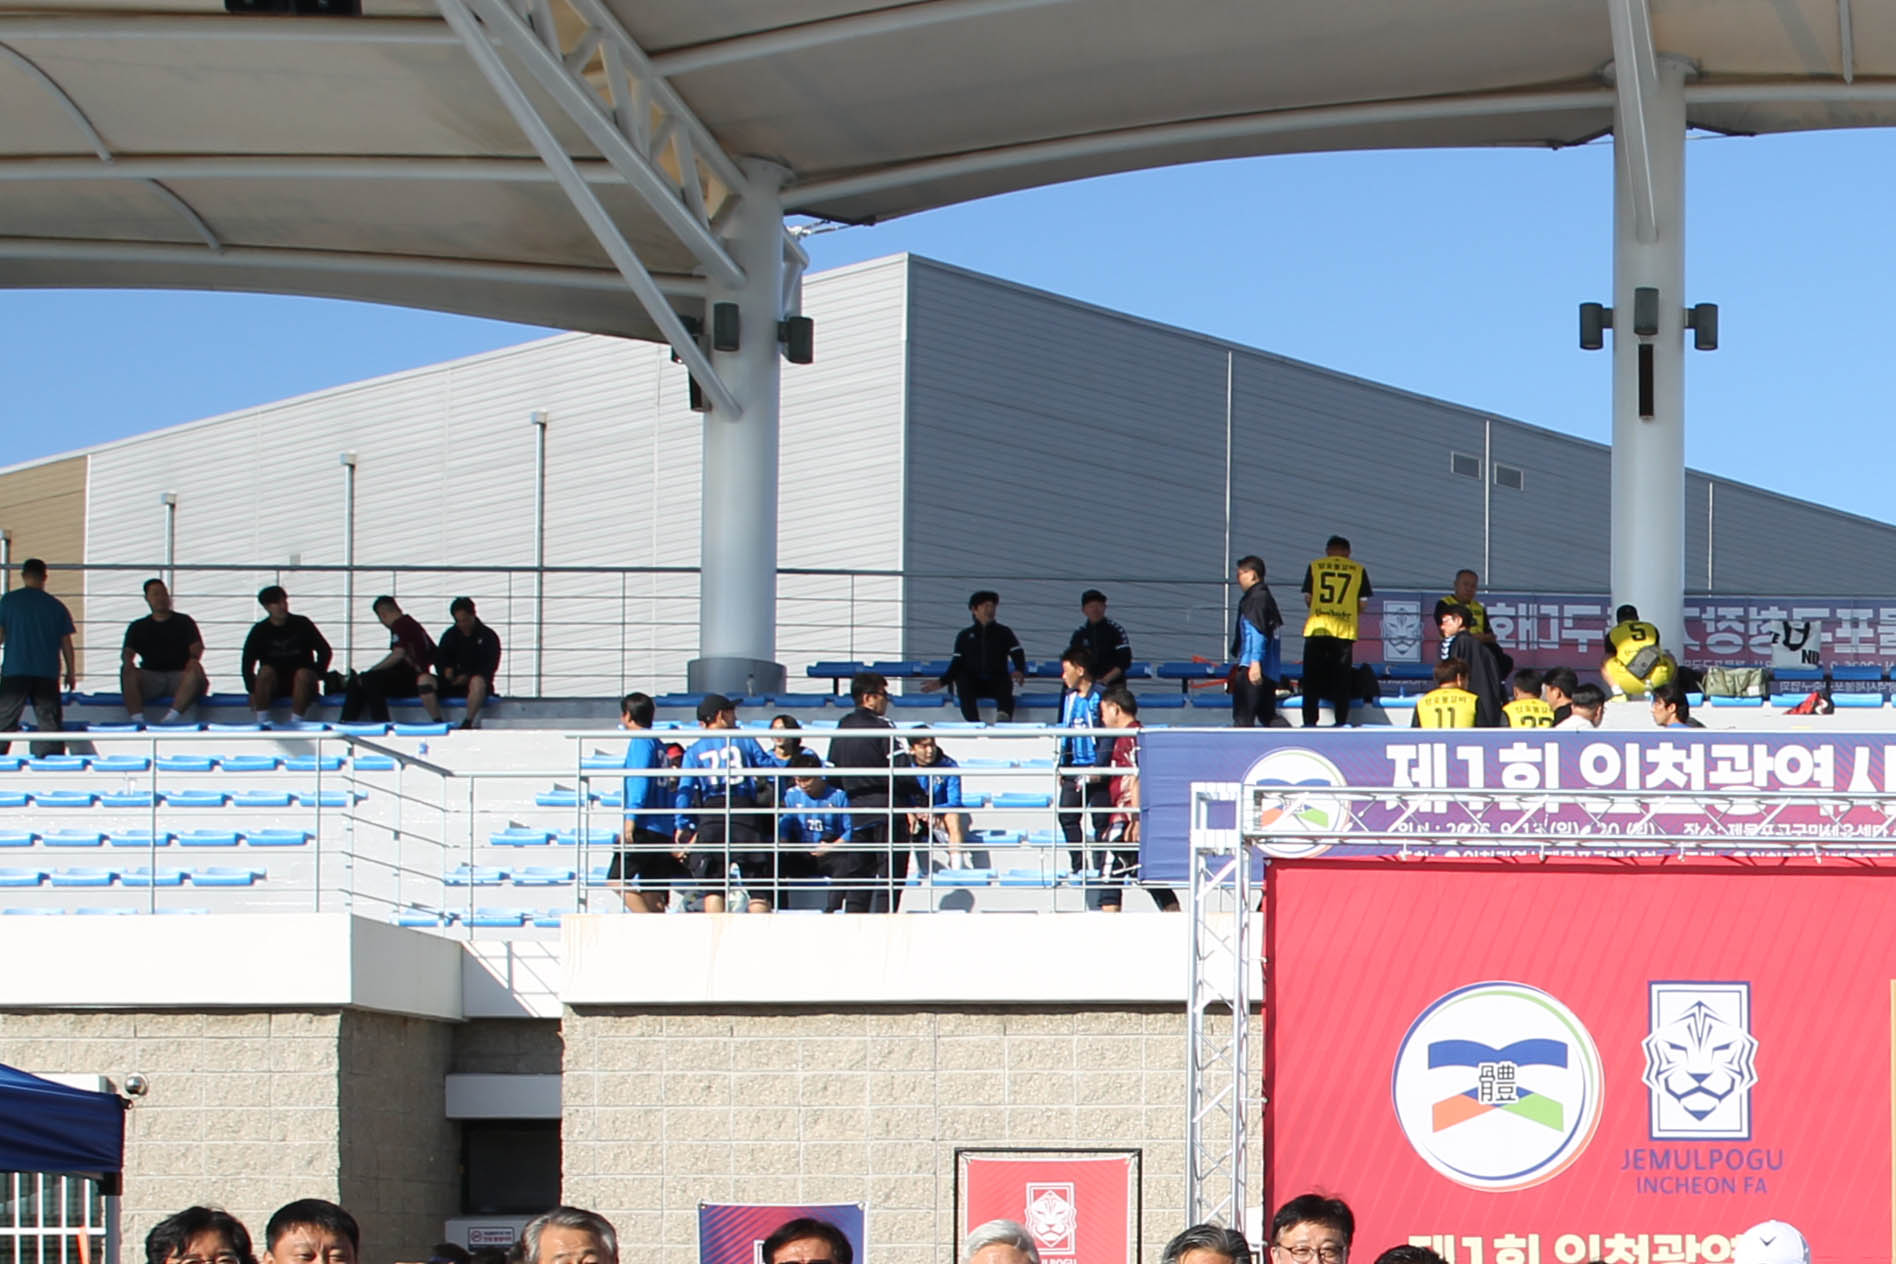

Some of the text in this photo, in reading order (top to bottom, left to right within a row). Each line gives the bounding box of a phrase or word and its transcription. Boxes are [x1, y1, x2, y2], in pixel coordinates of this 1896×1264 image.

[1319, 572, 1352, 604] 57
[1629, 623, 1646, 641] 5
[1386, 742, 1559, 814] 제1회
[1621, 1149, 1784, 1172] JEMULPOGU
[1637, 1176, 1768, 1195] INCHEON FA
